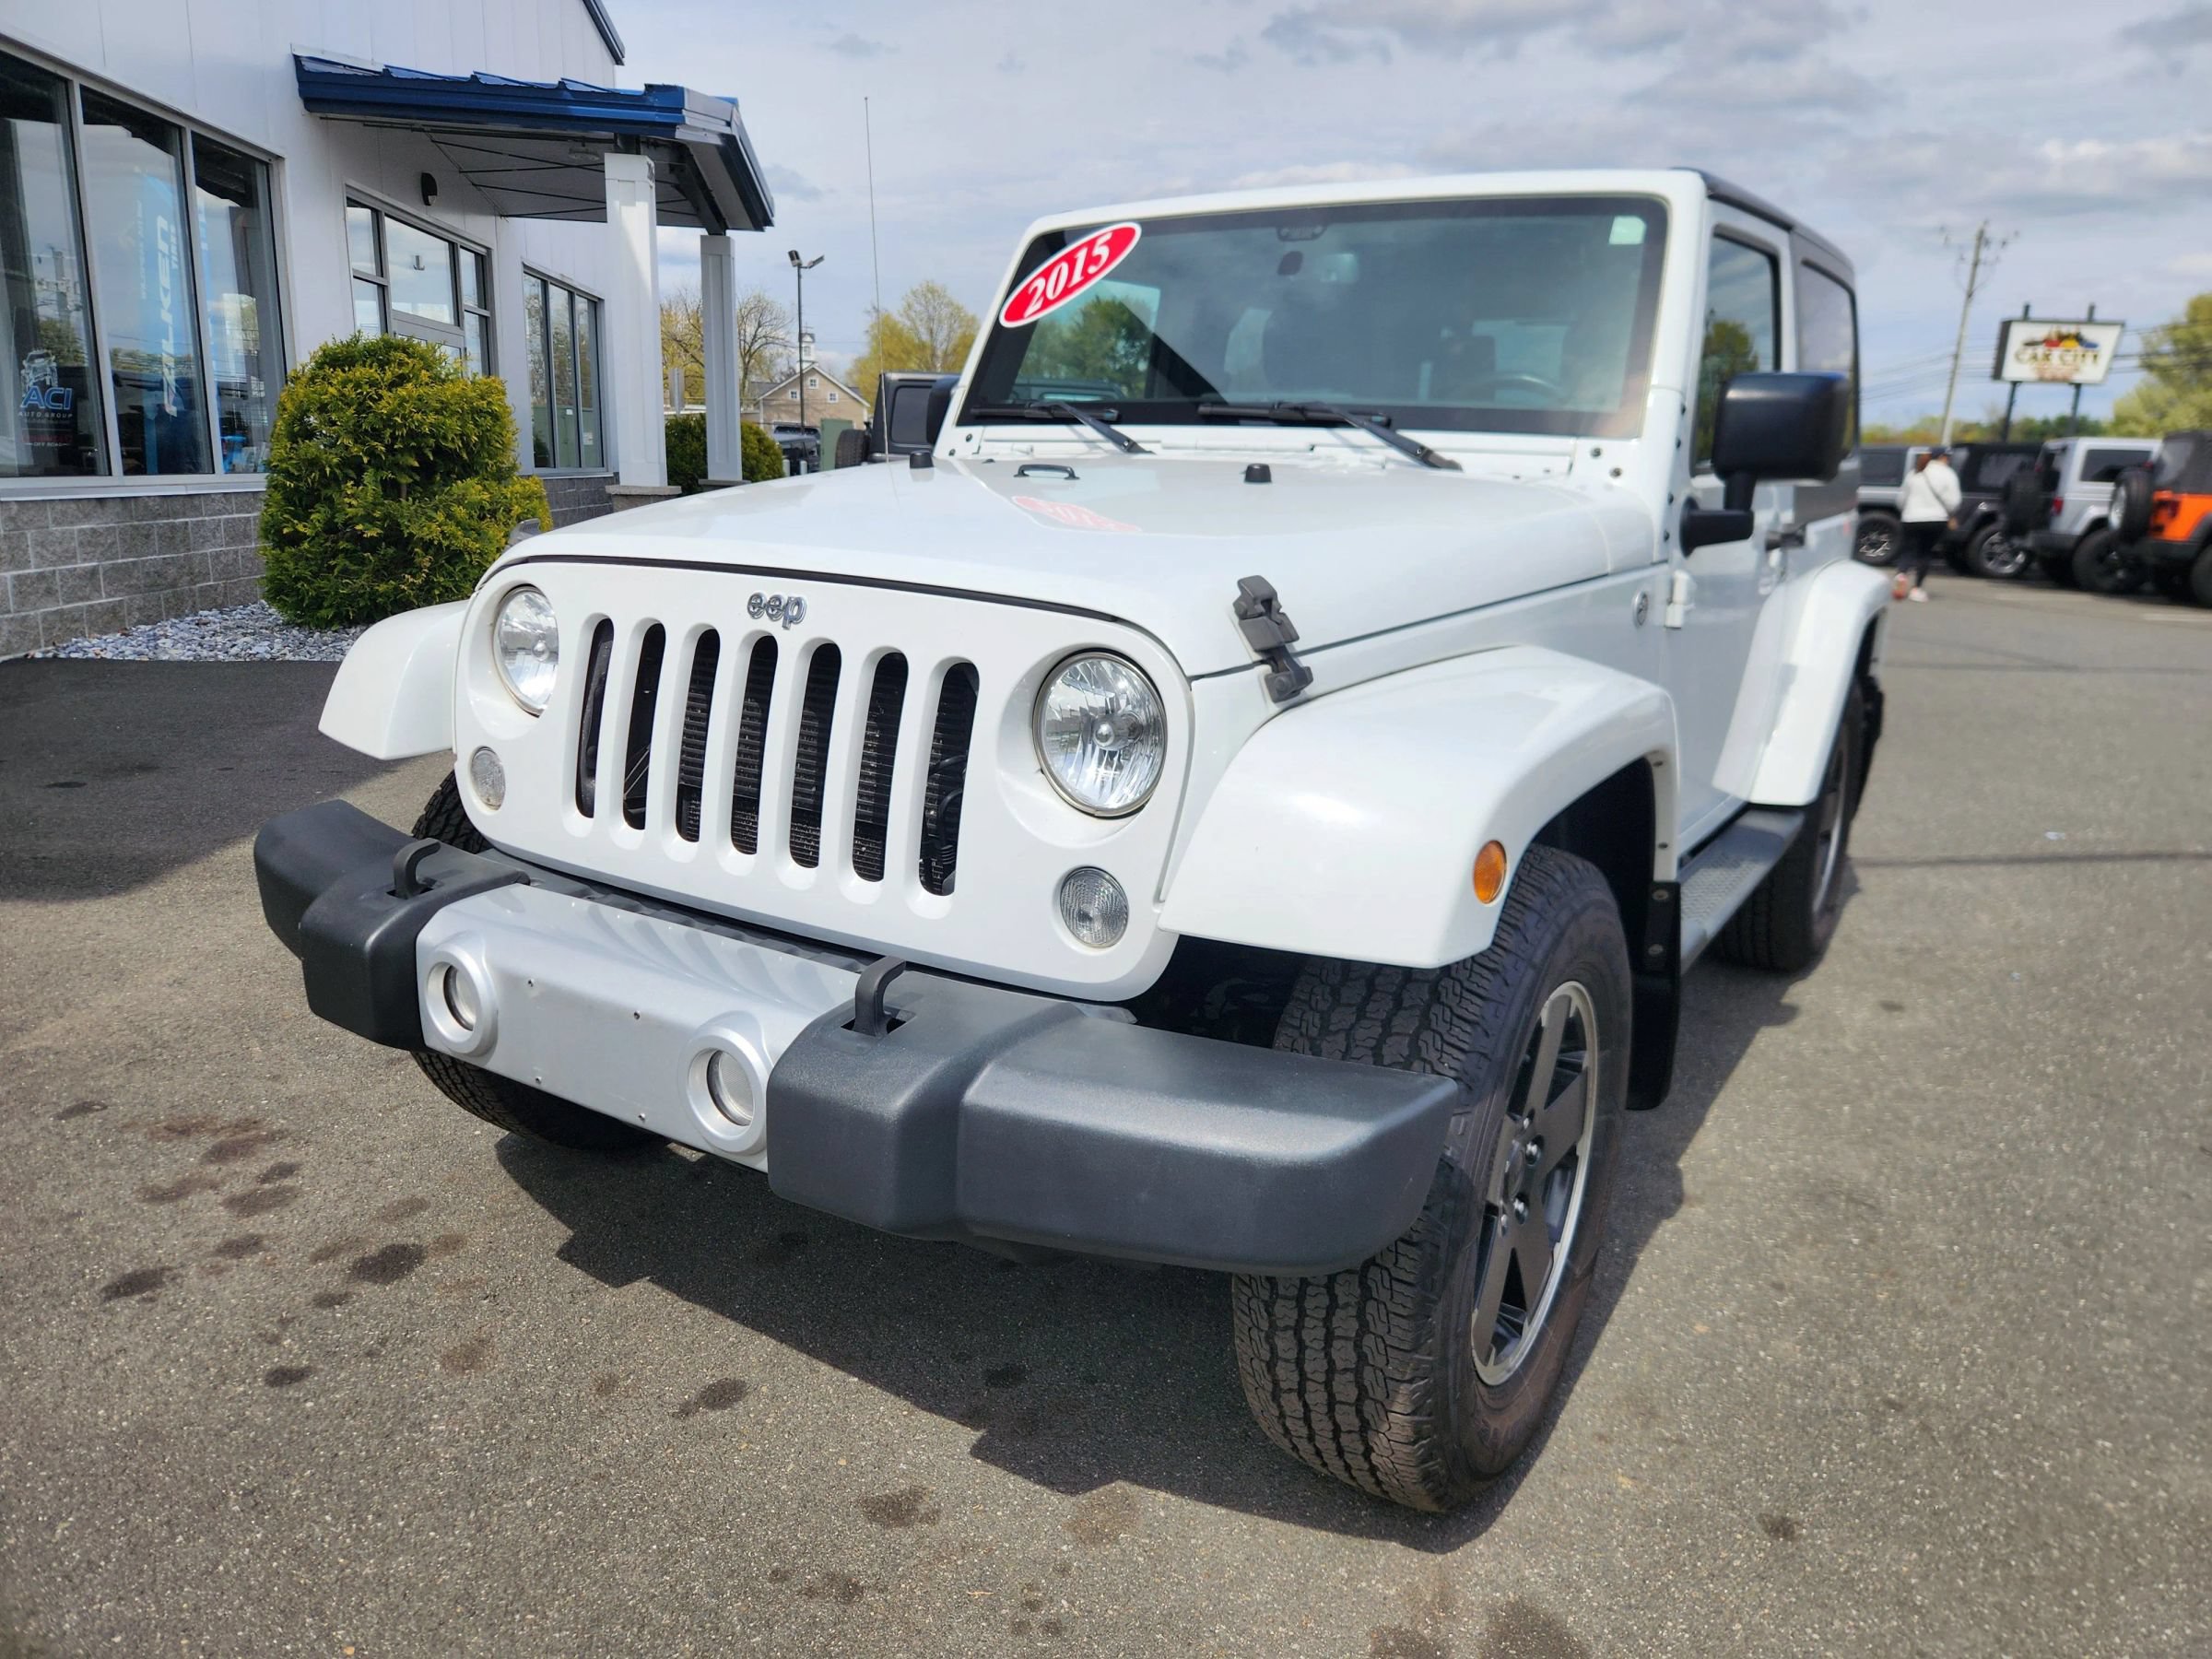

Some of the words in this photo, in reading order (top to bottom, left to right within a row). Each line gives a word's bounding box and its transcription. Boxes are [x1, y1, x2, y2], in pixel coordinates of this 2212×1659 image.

[1023, 231, 1112, 319] 2015
[20, 385, 73, 410] ACI
[44, 411, 73, 419] GROUP
